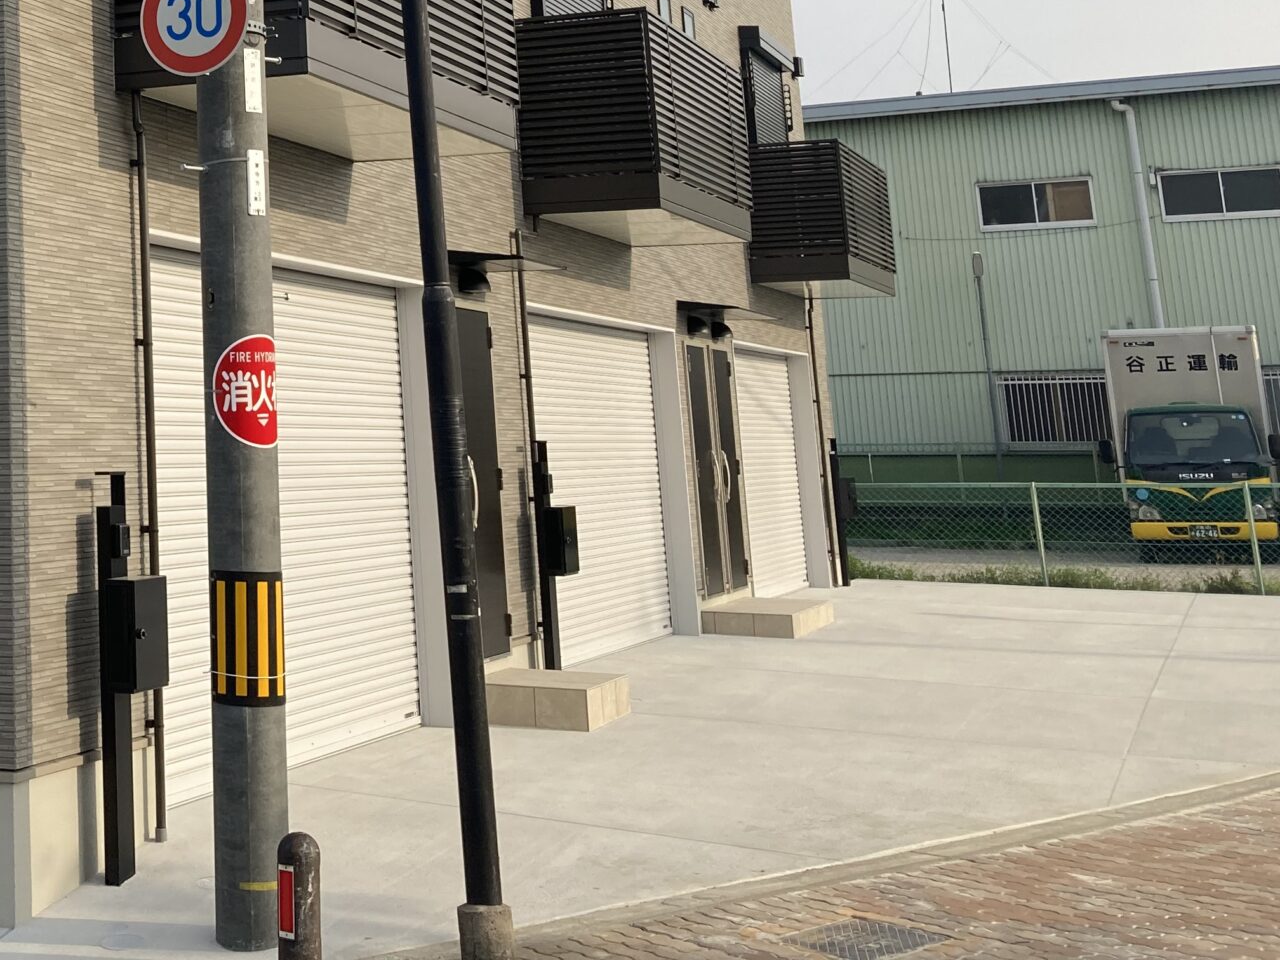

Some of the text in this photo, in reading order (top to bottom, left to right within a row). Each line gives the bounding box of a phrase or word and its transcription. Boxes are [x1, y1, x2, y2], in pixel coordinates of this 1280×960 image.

[230, 352, 251, 362] FIRE
[1125, 353, 1239, 374] 谷正運輸
[1178, 472, 1214, 480] ISUZU
